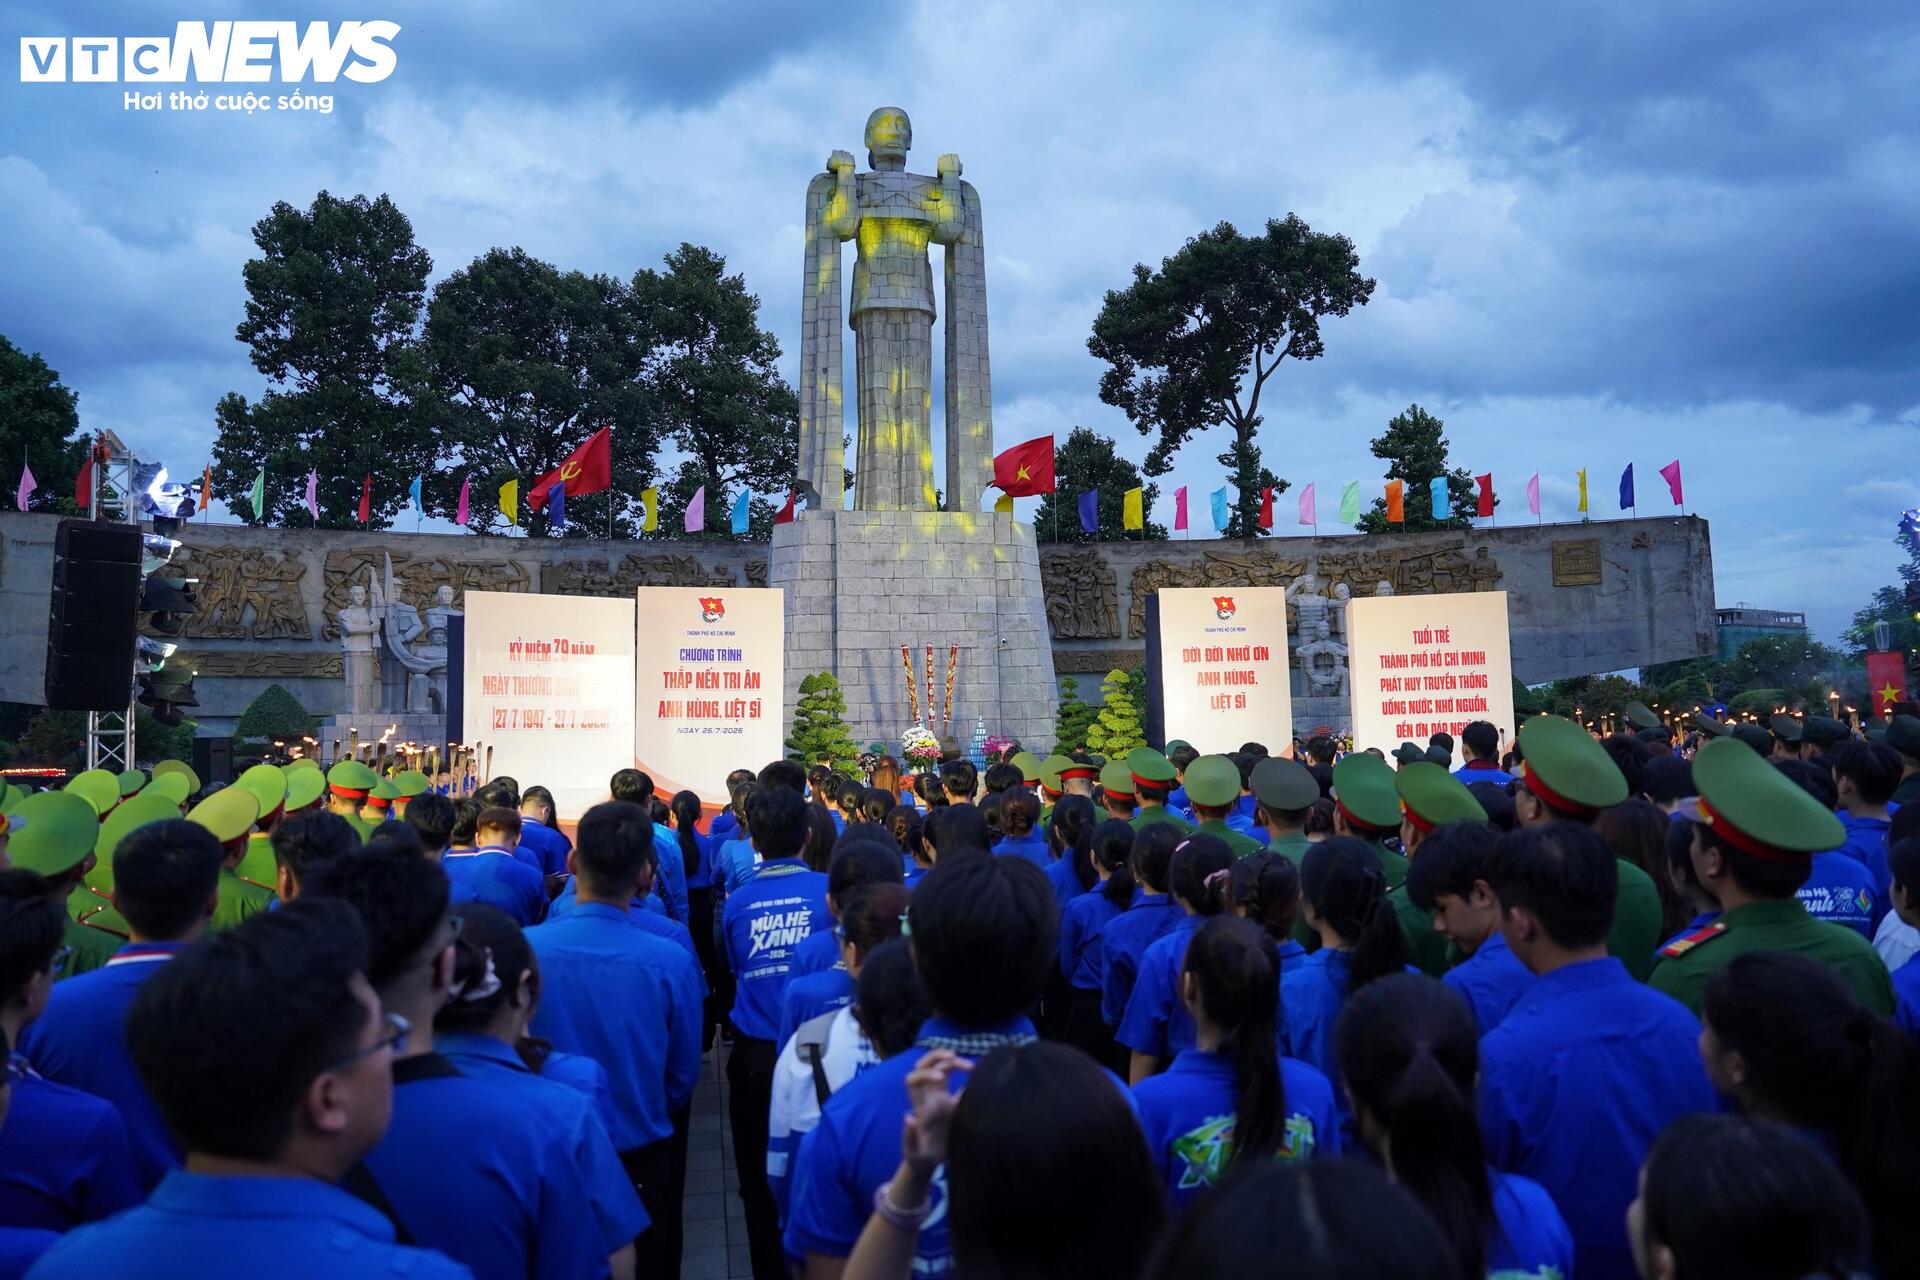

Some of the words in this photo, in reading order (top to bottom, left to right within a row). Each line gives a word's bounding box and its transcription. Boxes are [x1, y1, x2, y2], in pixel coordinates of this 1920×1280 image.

[1413, 624, 1433, 645] TUỔI
[1434, 625, 1450, 644] TRẺ
[509, 636, 522, 662] KỶ
[525, 640, 551, 667] NIỆM
[679, 648, 715, 662] CHƯƠNG
[717, 647, 742, 662] TRÌNH
[1205, 645, 1223, 662] ĐỜI
[1226, 644, 1250, 662] NHỚ
[1253, 645, 1269, 661] ƠN
[1380, 652, 1409, 669] THÀNH
[1411, 649, 1428, 668] PHỐ
[1430, 649, 1442, 667] HỒ
[1444, 650, 1459, 667] CHÍ
[1461, 651, 1486, 666] MINH
[482, 672, 510, 696] NGÀY
[512, 674, 552, 696] THƯƠNG
[663, 665, 693, 689] THẮP
[696, 667, 720, 689] NẾN
[723, 671, 741, 689] TRI
[743, 669, 761, 689] ÂN
[1197, 671, 1220, 686] ANH
[1380, 675, 1402, 692] PHÁT
[1404, 677, 1421, 691] HUY
[1423, 672, 1457, 691] TRUYỀN
[1459, 671, 1488, 689] THỐNG
[658, 700, 683, 718] ANH
[724, 698, 747, 722] LIỆT
[749, 698, 762, 718] SĨ
[1210, 692, 1232, 712] LIỆT
[1235, 692, 1247, 709] SĨ
[1382, 697, 1406, 715] UỐNG
[1409, 697, 1432, 714] NƯỚC
[1435, 696, 1454, 713] NHỚ
[1396, 720, 1414, 738] ĐỀN
[1416, 722, 1428, 737] ƠN
[1795, 888, 1813, 898] ùa
[1803, 895, 1836, 912] anh
[749, 911, 785, 940] MÙA
[785, 906, 813, 928] HÈ
[748, 926, 811, 960] XANH
